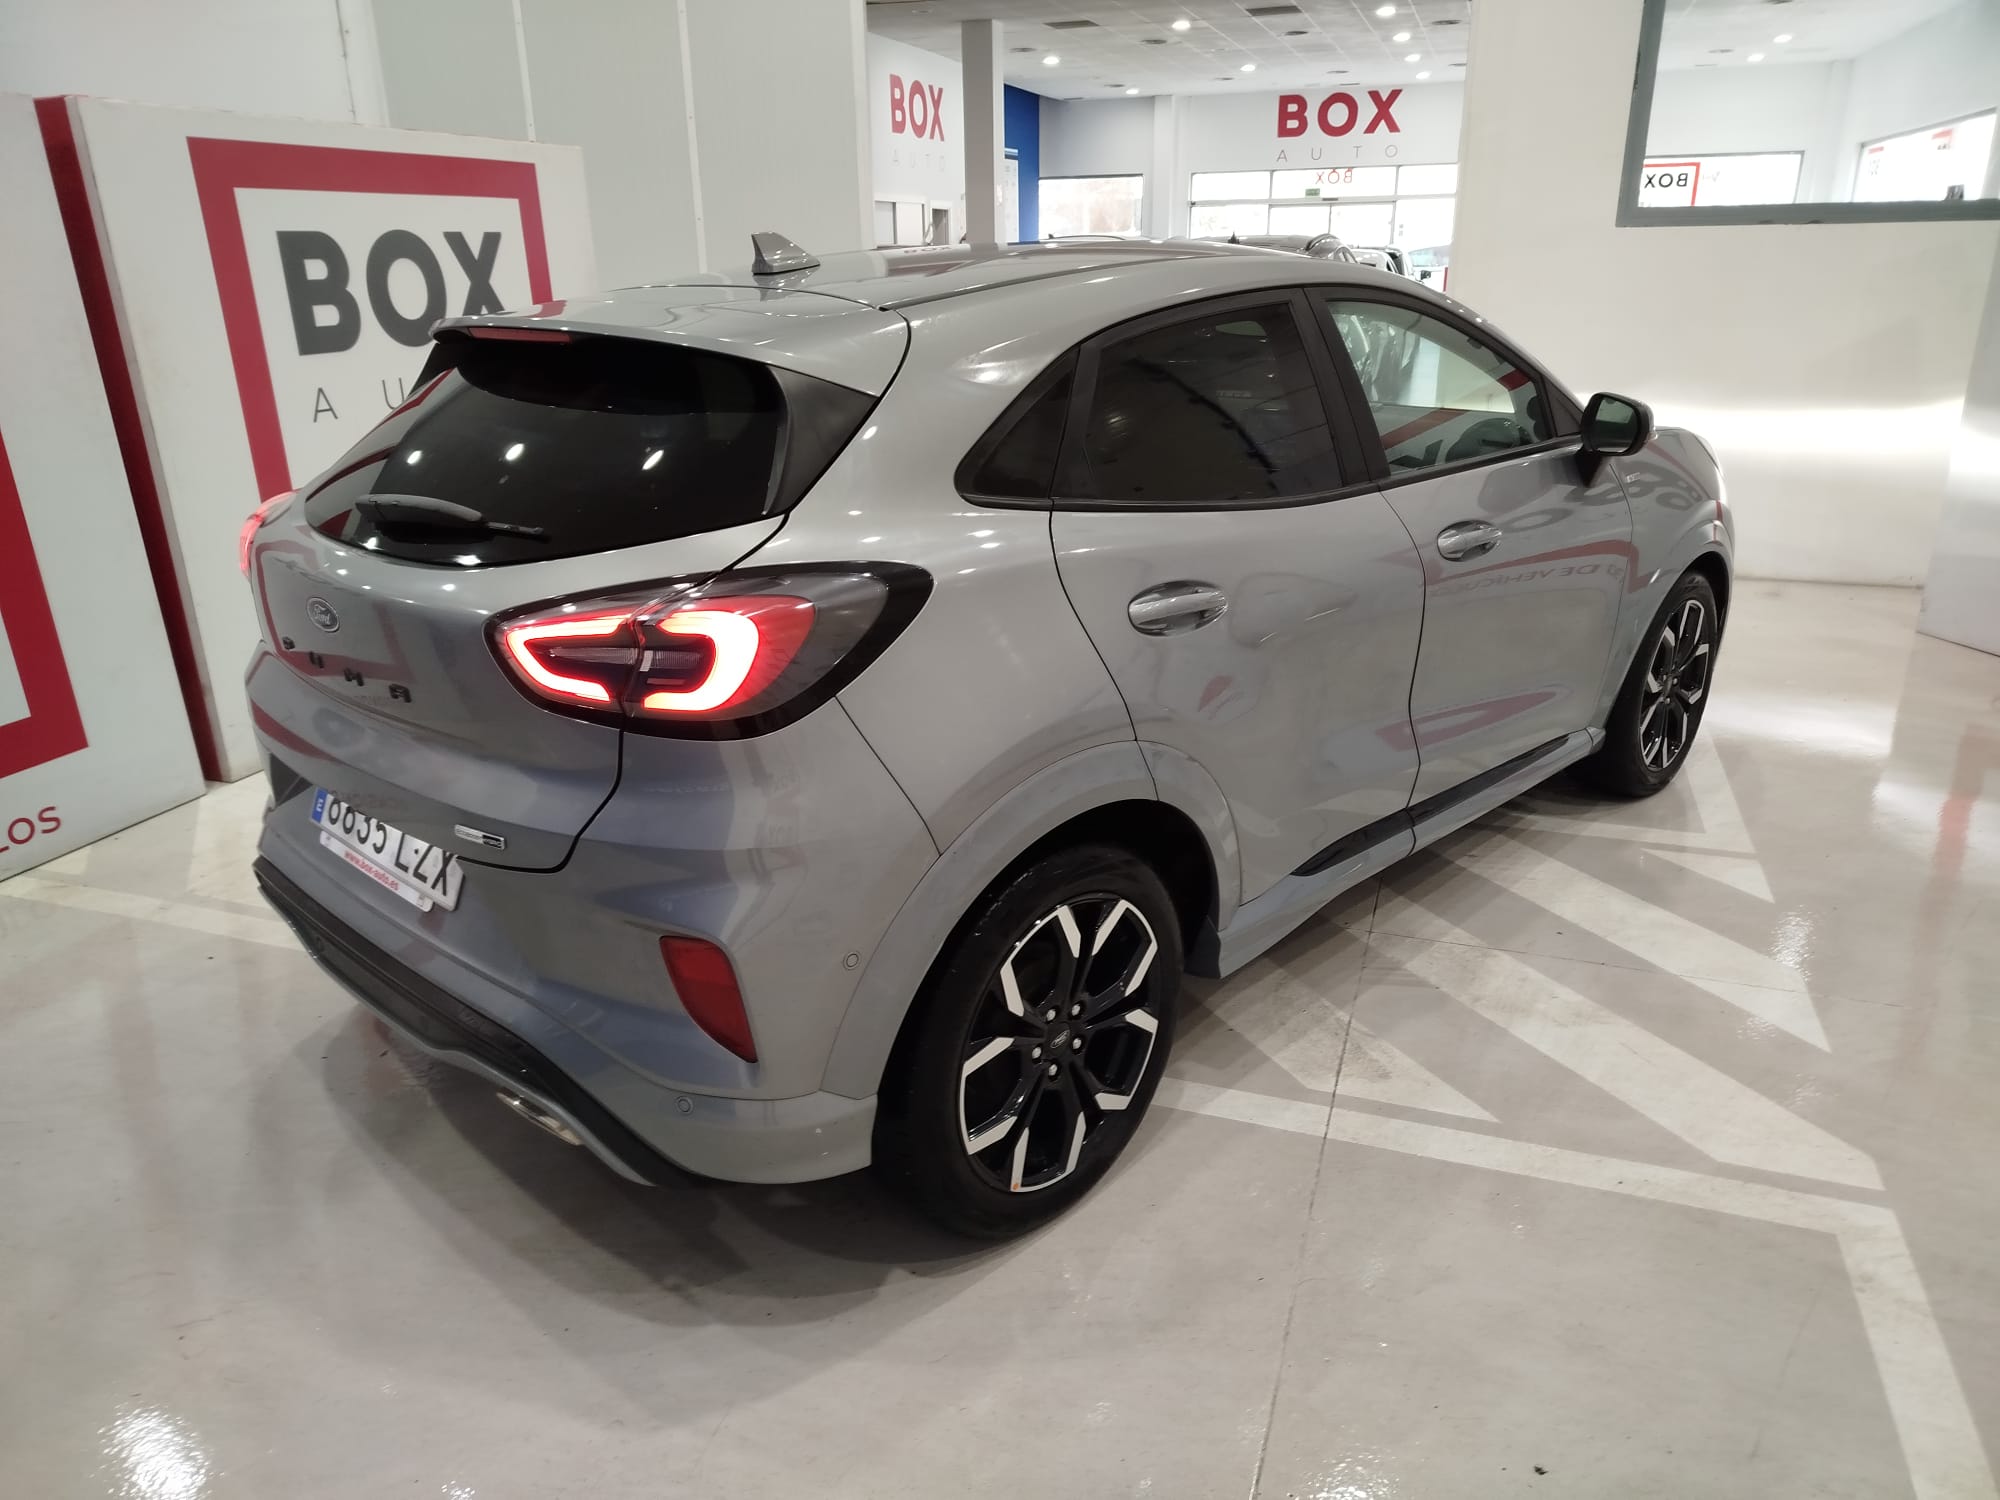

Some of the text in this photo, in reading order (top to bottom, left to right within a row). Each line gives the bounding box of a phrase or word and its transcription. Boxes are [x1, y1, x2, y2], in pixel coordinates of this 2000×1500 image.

[889, 73, 945, 142] BOX
[1277, 88, 1403, 138] BOX
[1276, 145, 1398, 163] AUTO
[275, 229, 505, 356] BOX
[313, 377, 406, 423] AU
[394, 831, 456, 897] LZX
